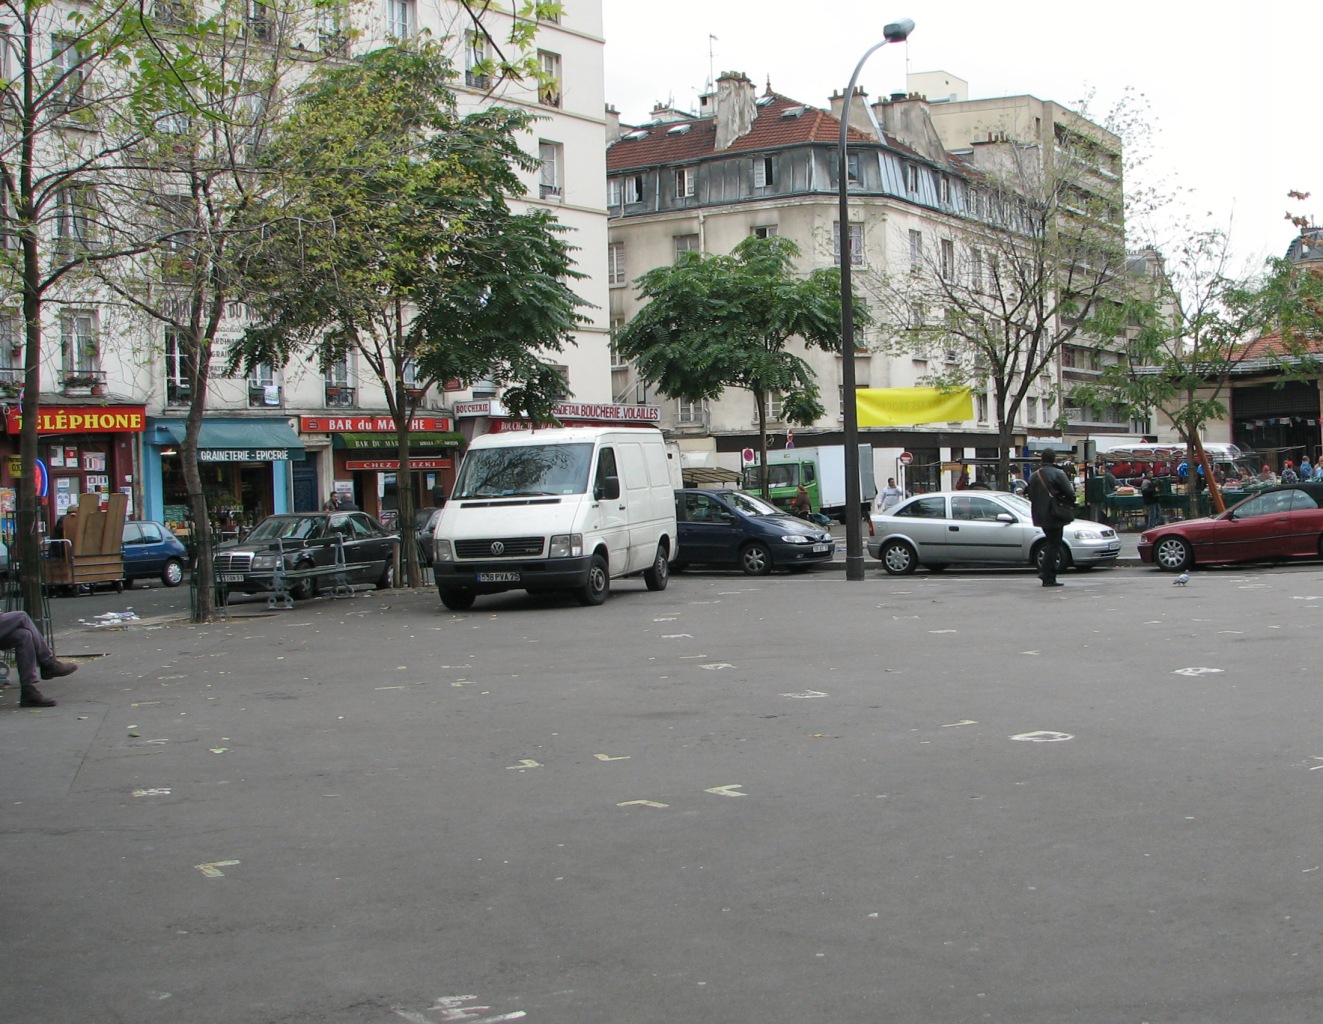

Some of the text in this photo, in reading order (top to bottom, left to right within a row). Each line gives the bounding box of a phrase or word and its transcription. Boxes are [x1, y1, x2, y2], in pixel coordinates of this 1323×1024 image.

[455, 404, 489, 414] BOUCHERIE
[581, 405, 620, 419] BOUCHERIE
[329, 420, 425, 430] BAR du MAHE
[200, 450, 250, 461] GRAINETERIE
[256, 450, 289, 460] EPICERIE
